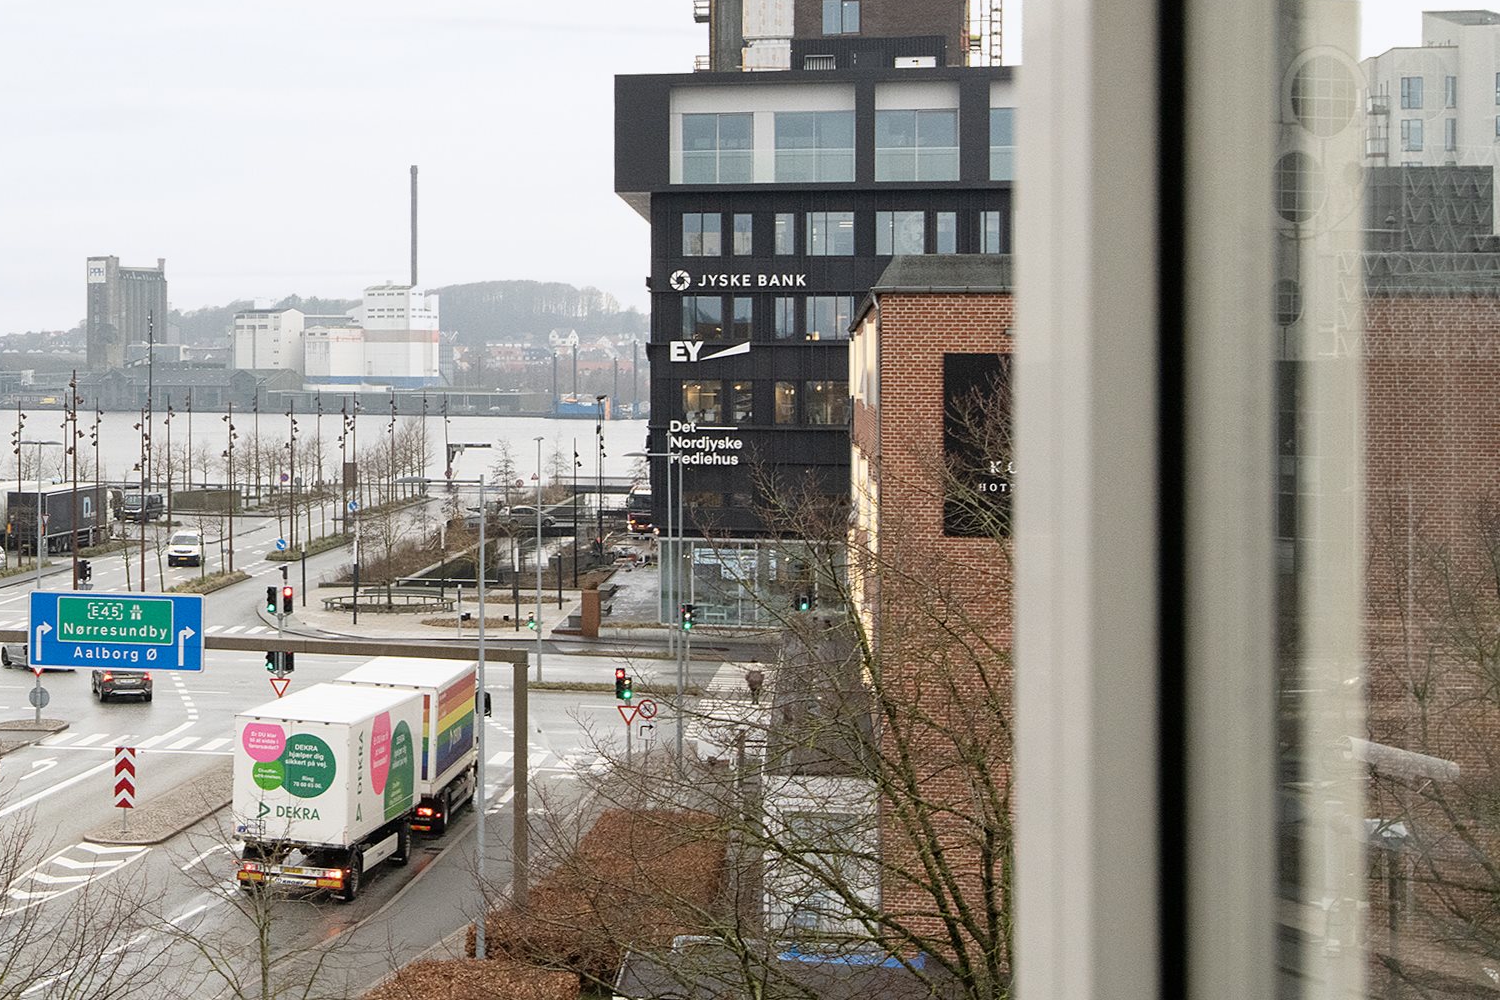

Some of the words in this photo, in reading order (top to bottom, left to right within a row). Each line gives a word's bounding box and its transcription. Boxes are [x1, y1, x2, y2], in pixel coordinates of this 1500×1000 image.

[698, 274, 751, 287] JYSKE
[758, 274, 807, 287] BANK
[670, 341, 704, 362] EY
[670, 421, 697, 433] Det
[670, 437, 743, 452] Nordjyske
[92, 606, 119, 617] E45
[64, 623, 168, 640] Nørresundby
[73, 646, 139, 662] Aalborg
[146, 648, 157, 661] Ø
[295, 743, 318, 752] DEKRA
[289, 751, 313, 759] hjælper
[314, 753, 324, 761] dig
[276, 805, 320, 820] DEKRA
